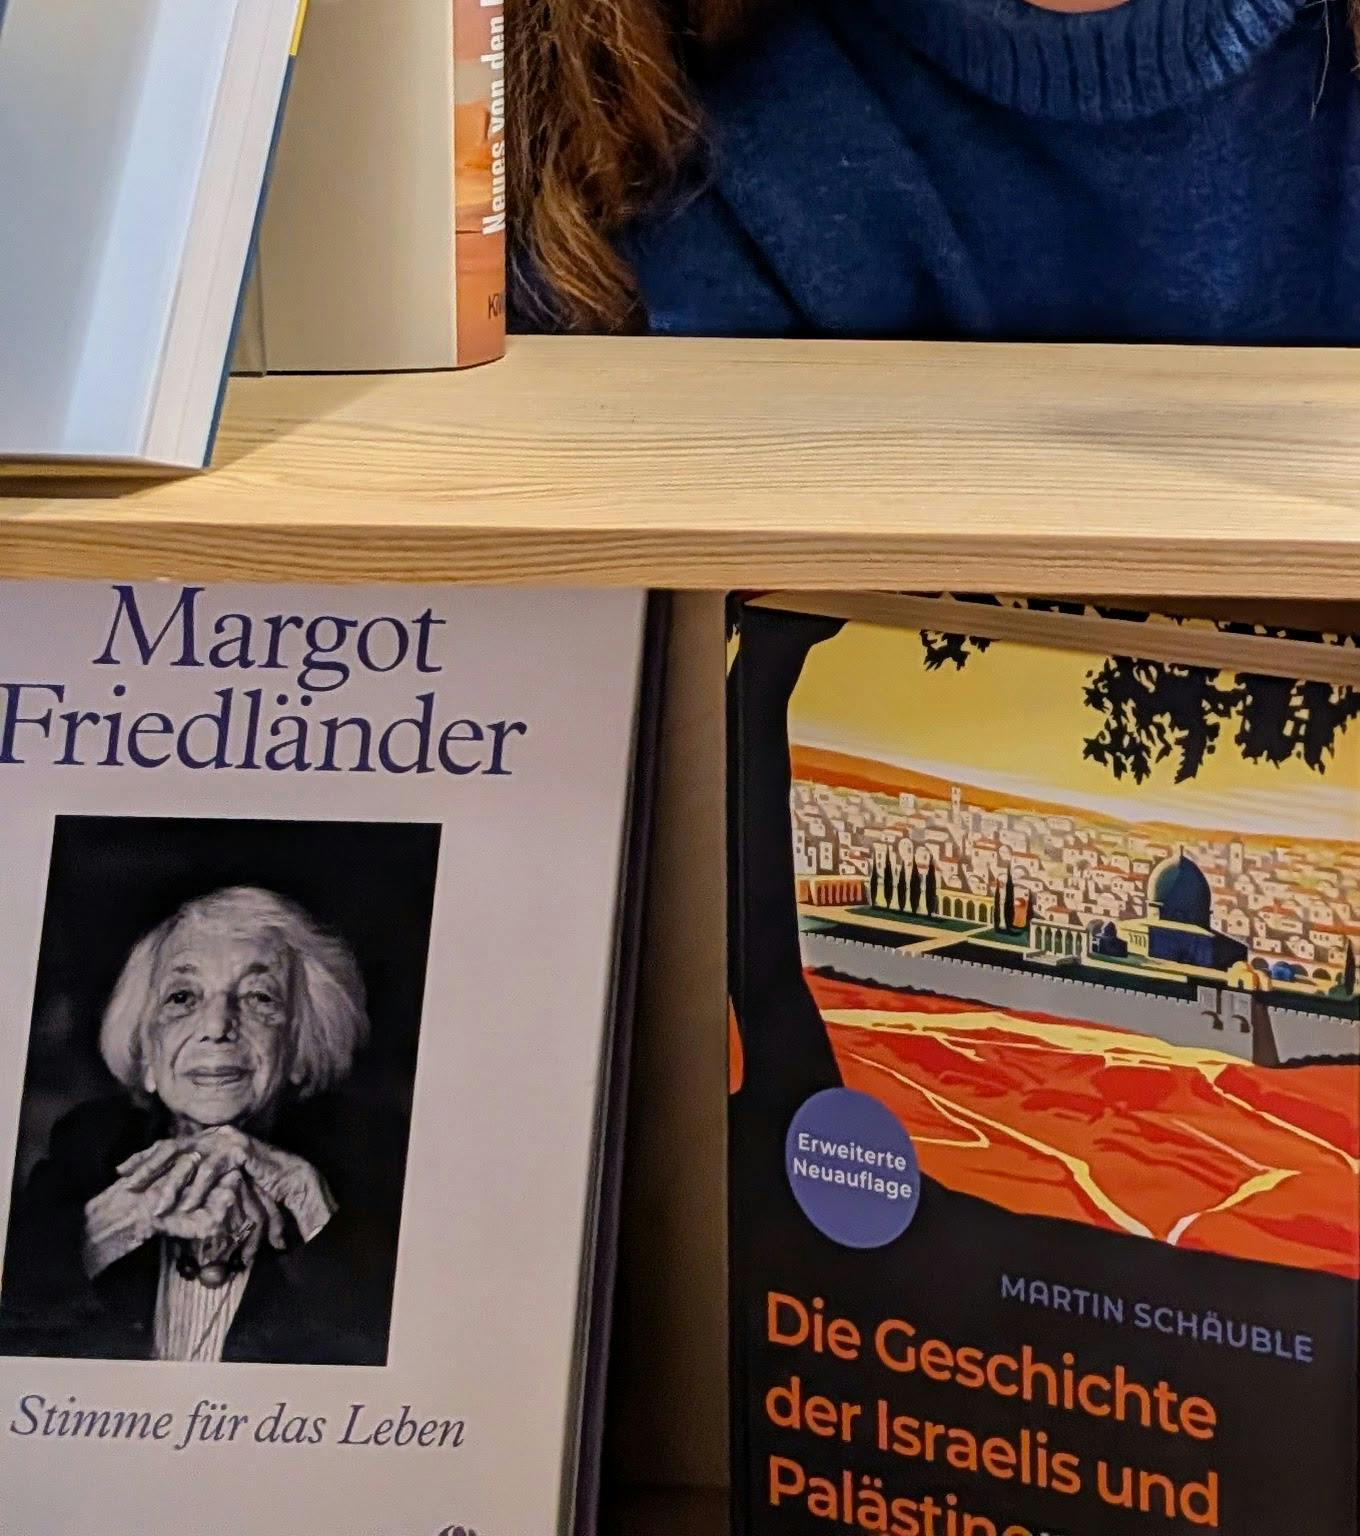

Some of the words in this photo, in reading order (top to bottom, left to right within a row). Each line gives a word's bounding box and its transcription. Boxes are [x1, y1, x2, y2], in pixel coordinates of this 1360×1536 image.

[490, 80, 505, 133] von
[481, 142, 505, 236] Neues
[92, 584, 447, 693] Margot
[0, 682, 529, 776] Friedländer
[792, 1157, 913, 1200] Neuauflage
[797, 1131, 908, 1173] Erweiterte
[1000, 1273, 1125, 1324] MARTIN
[1134, 1299, 1313, 1364] SCHÄUBLE
[766, 1291, 862, 1360] Die
[876, 1317, 1218, 1441] Geschichte
[10, 1392, 174, 1440] Stimme
[173, 1399, 249, 1451] für
[254, 1402, 327, 1445] das
[338, 1403, 467, 1449] Leben
[765, 1376, 861, 1442] der
[877, 1399, 1081, 1496] Israelis
[1097, 1460, 1219, 1528] und
[768, 1454, 1050, 1536] Palästin
